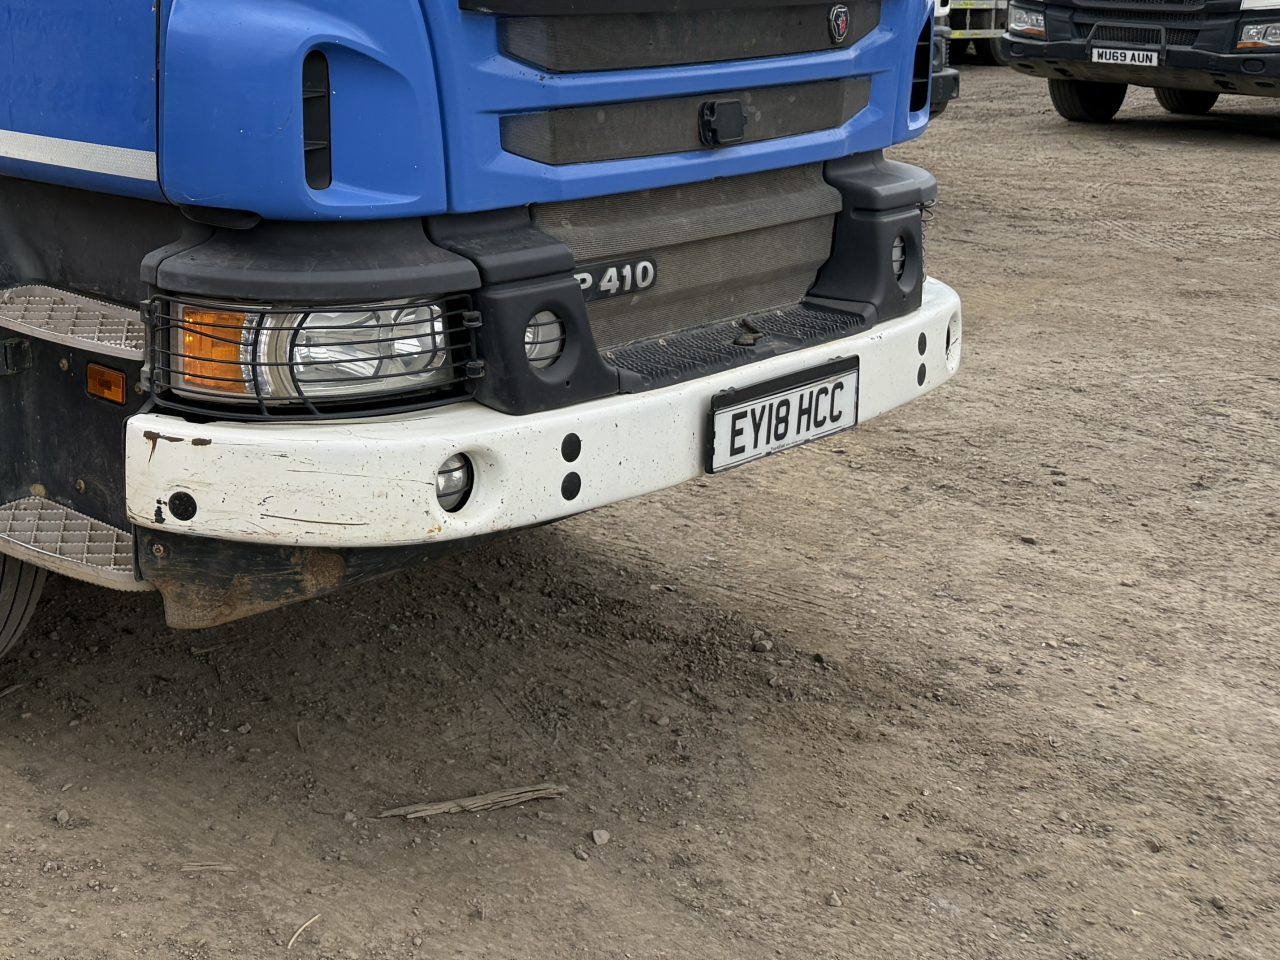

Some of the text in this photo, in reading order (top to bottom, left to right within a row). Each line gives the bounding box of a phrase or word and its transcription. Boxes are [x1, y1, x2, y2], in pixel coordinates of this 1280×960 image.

[1097, 50, 1153, 64] WU69 AUN
[573, 261, 654, 293] P 410
[729, 381, 845, 457] EY18 HCC
